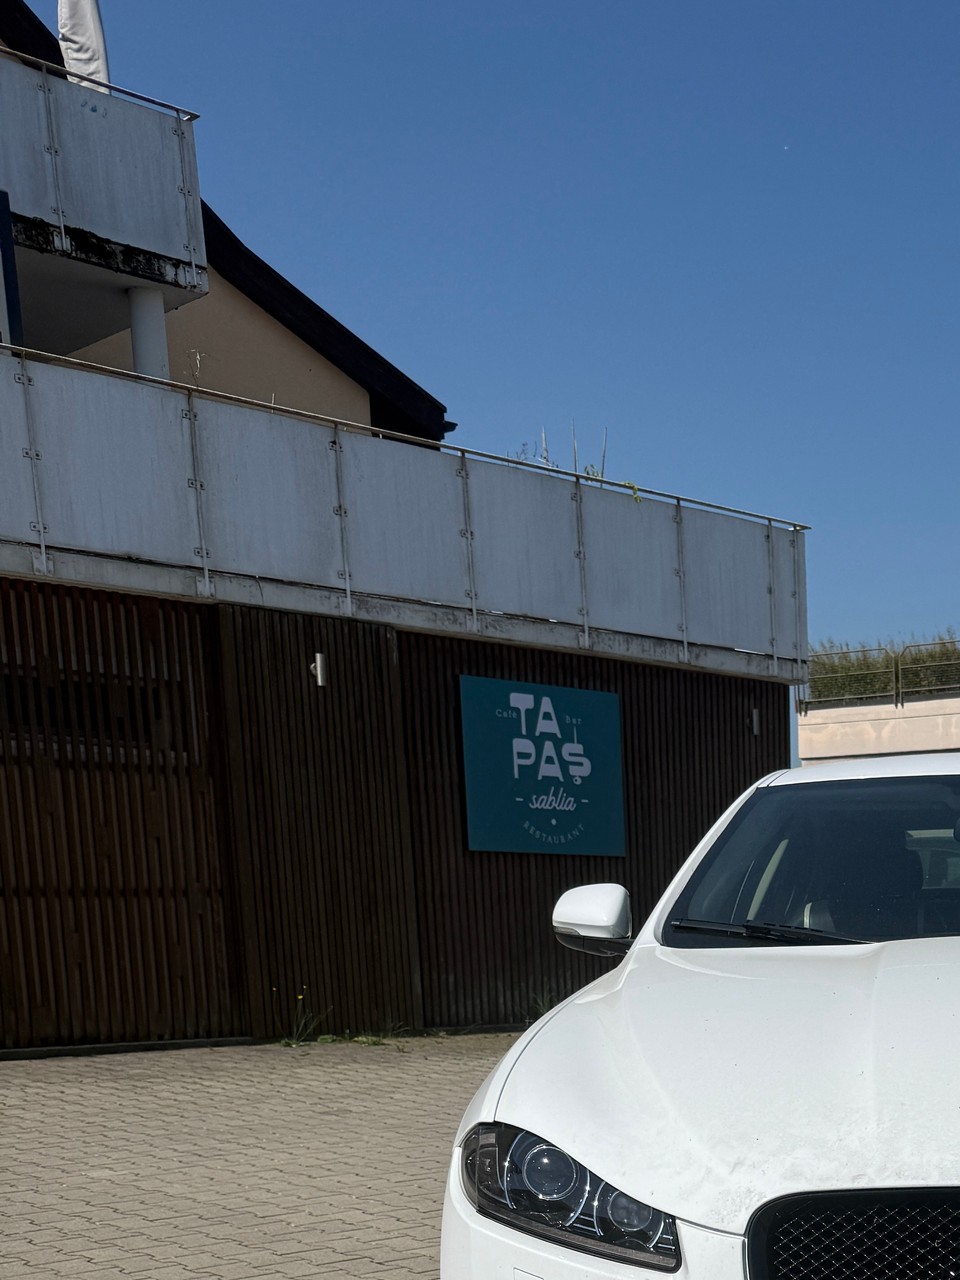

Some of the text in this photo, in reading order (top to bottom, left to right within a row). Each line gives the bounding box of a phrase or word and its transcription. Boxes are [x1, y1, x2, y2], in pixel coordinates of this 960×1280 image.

[509, 692, 562, 738] TA
[565, 715, 582, 725] Bar
[529, 786, 576, 811] sablia
[523, 820, 584, 844] RESTAURANT
